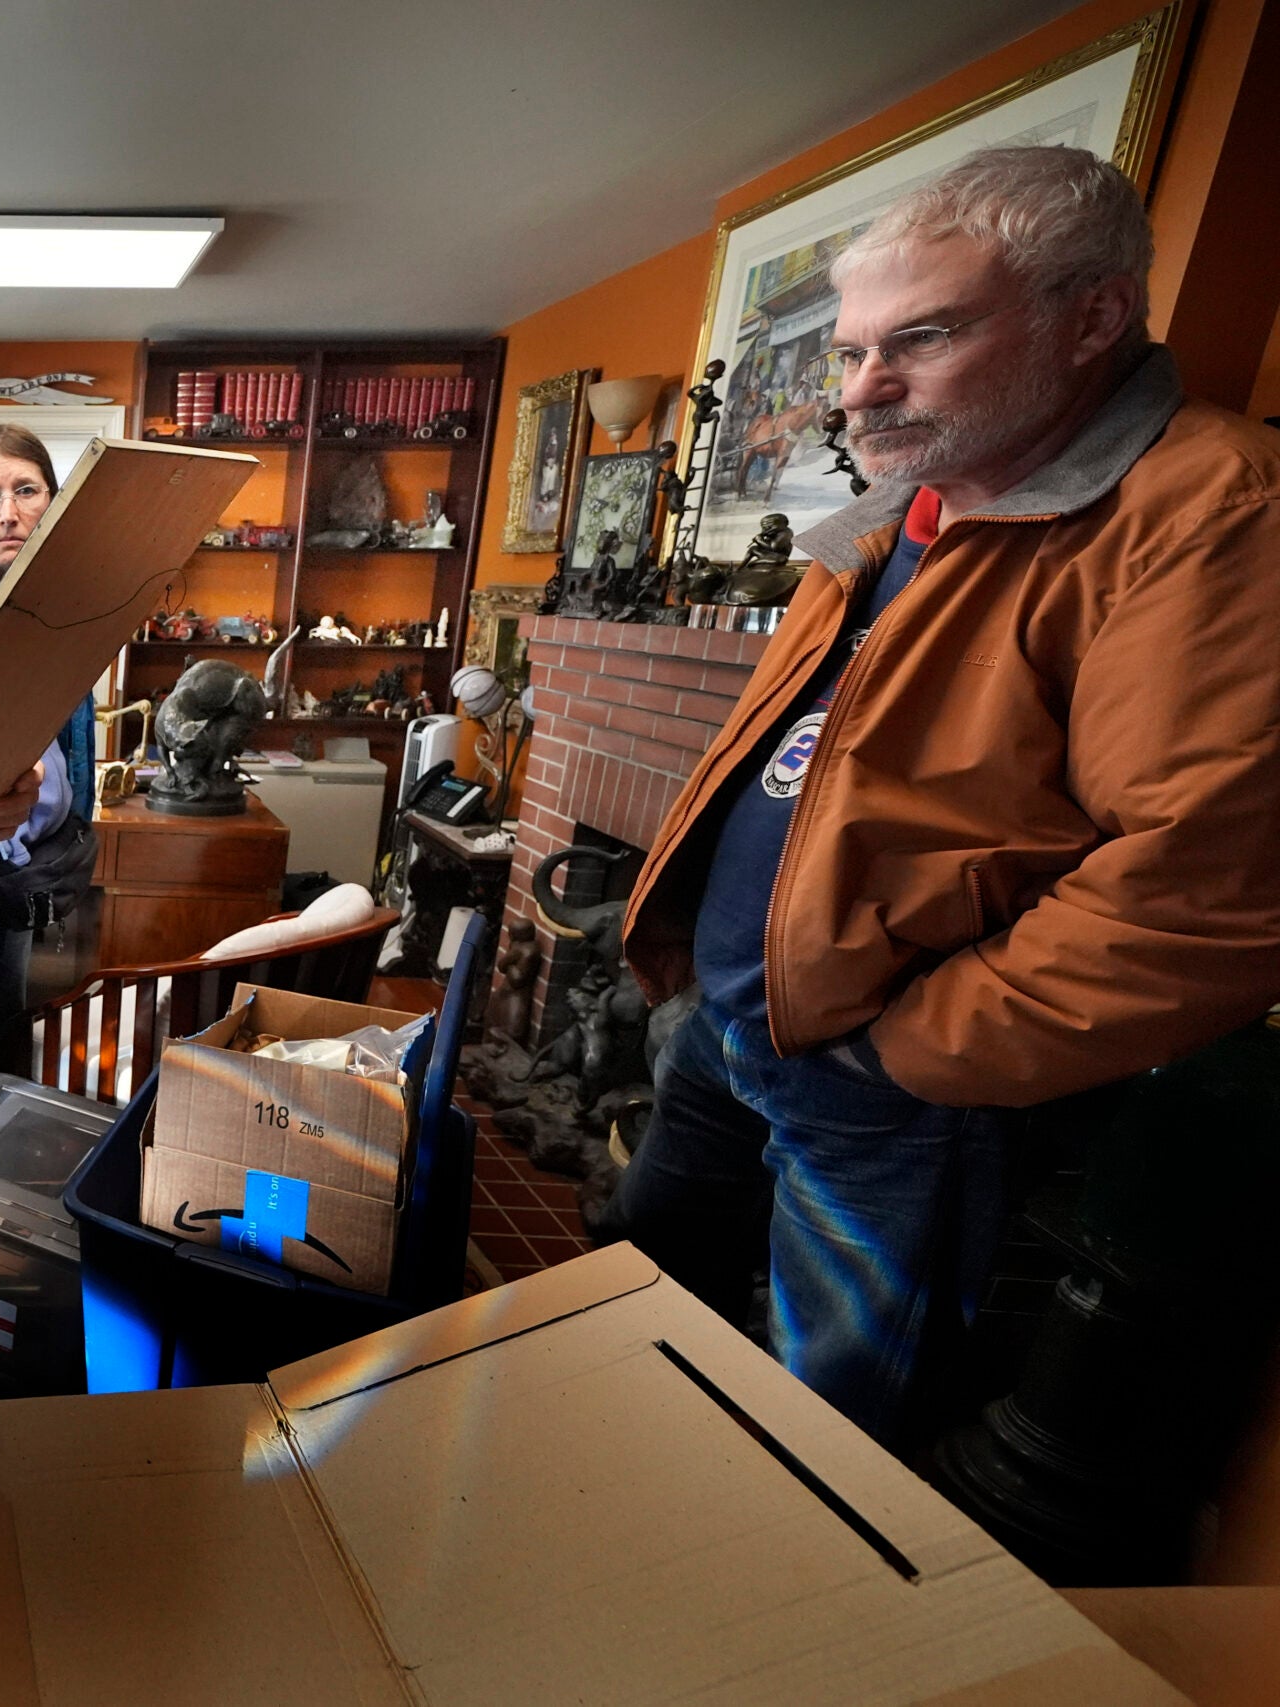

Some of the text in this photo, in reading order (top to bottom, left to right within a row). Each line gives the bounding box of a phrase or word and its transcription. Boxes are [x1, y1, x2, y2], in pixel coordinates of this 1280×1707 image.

[0, 373, 66, 396] WE ARE ONE
[777, 733, 819, 772] 2
[765, 777, 790, 793] NASCAR
[254, 1101, 324, 1138] 118 ZM5
[267, 1175, 280, 1210] It's on
